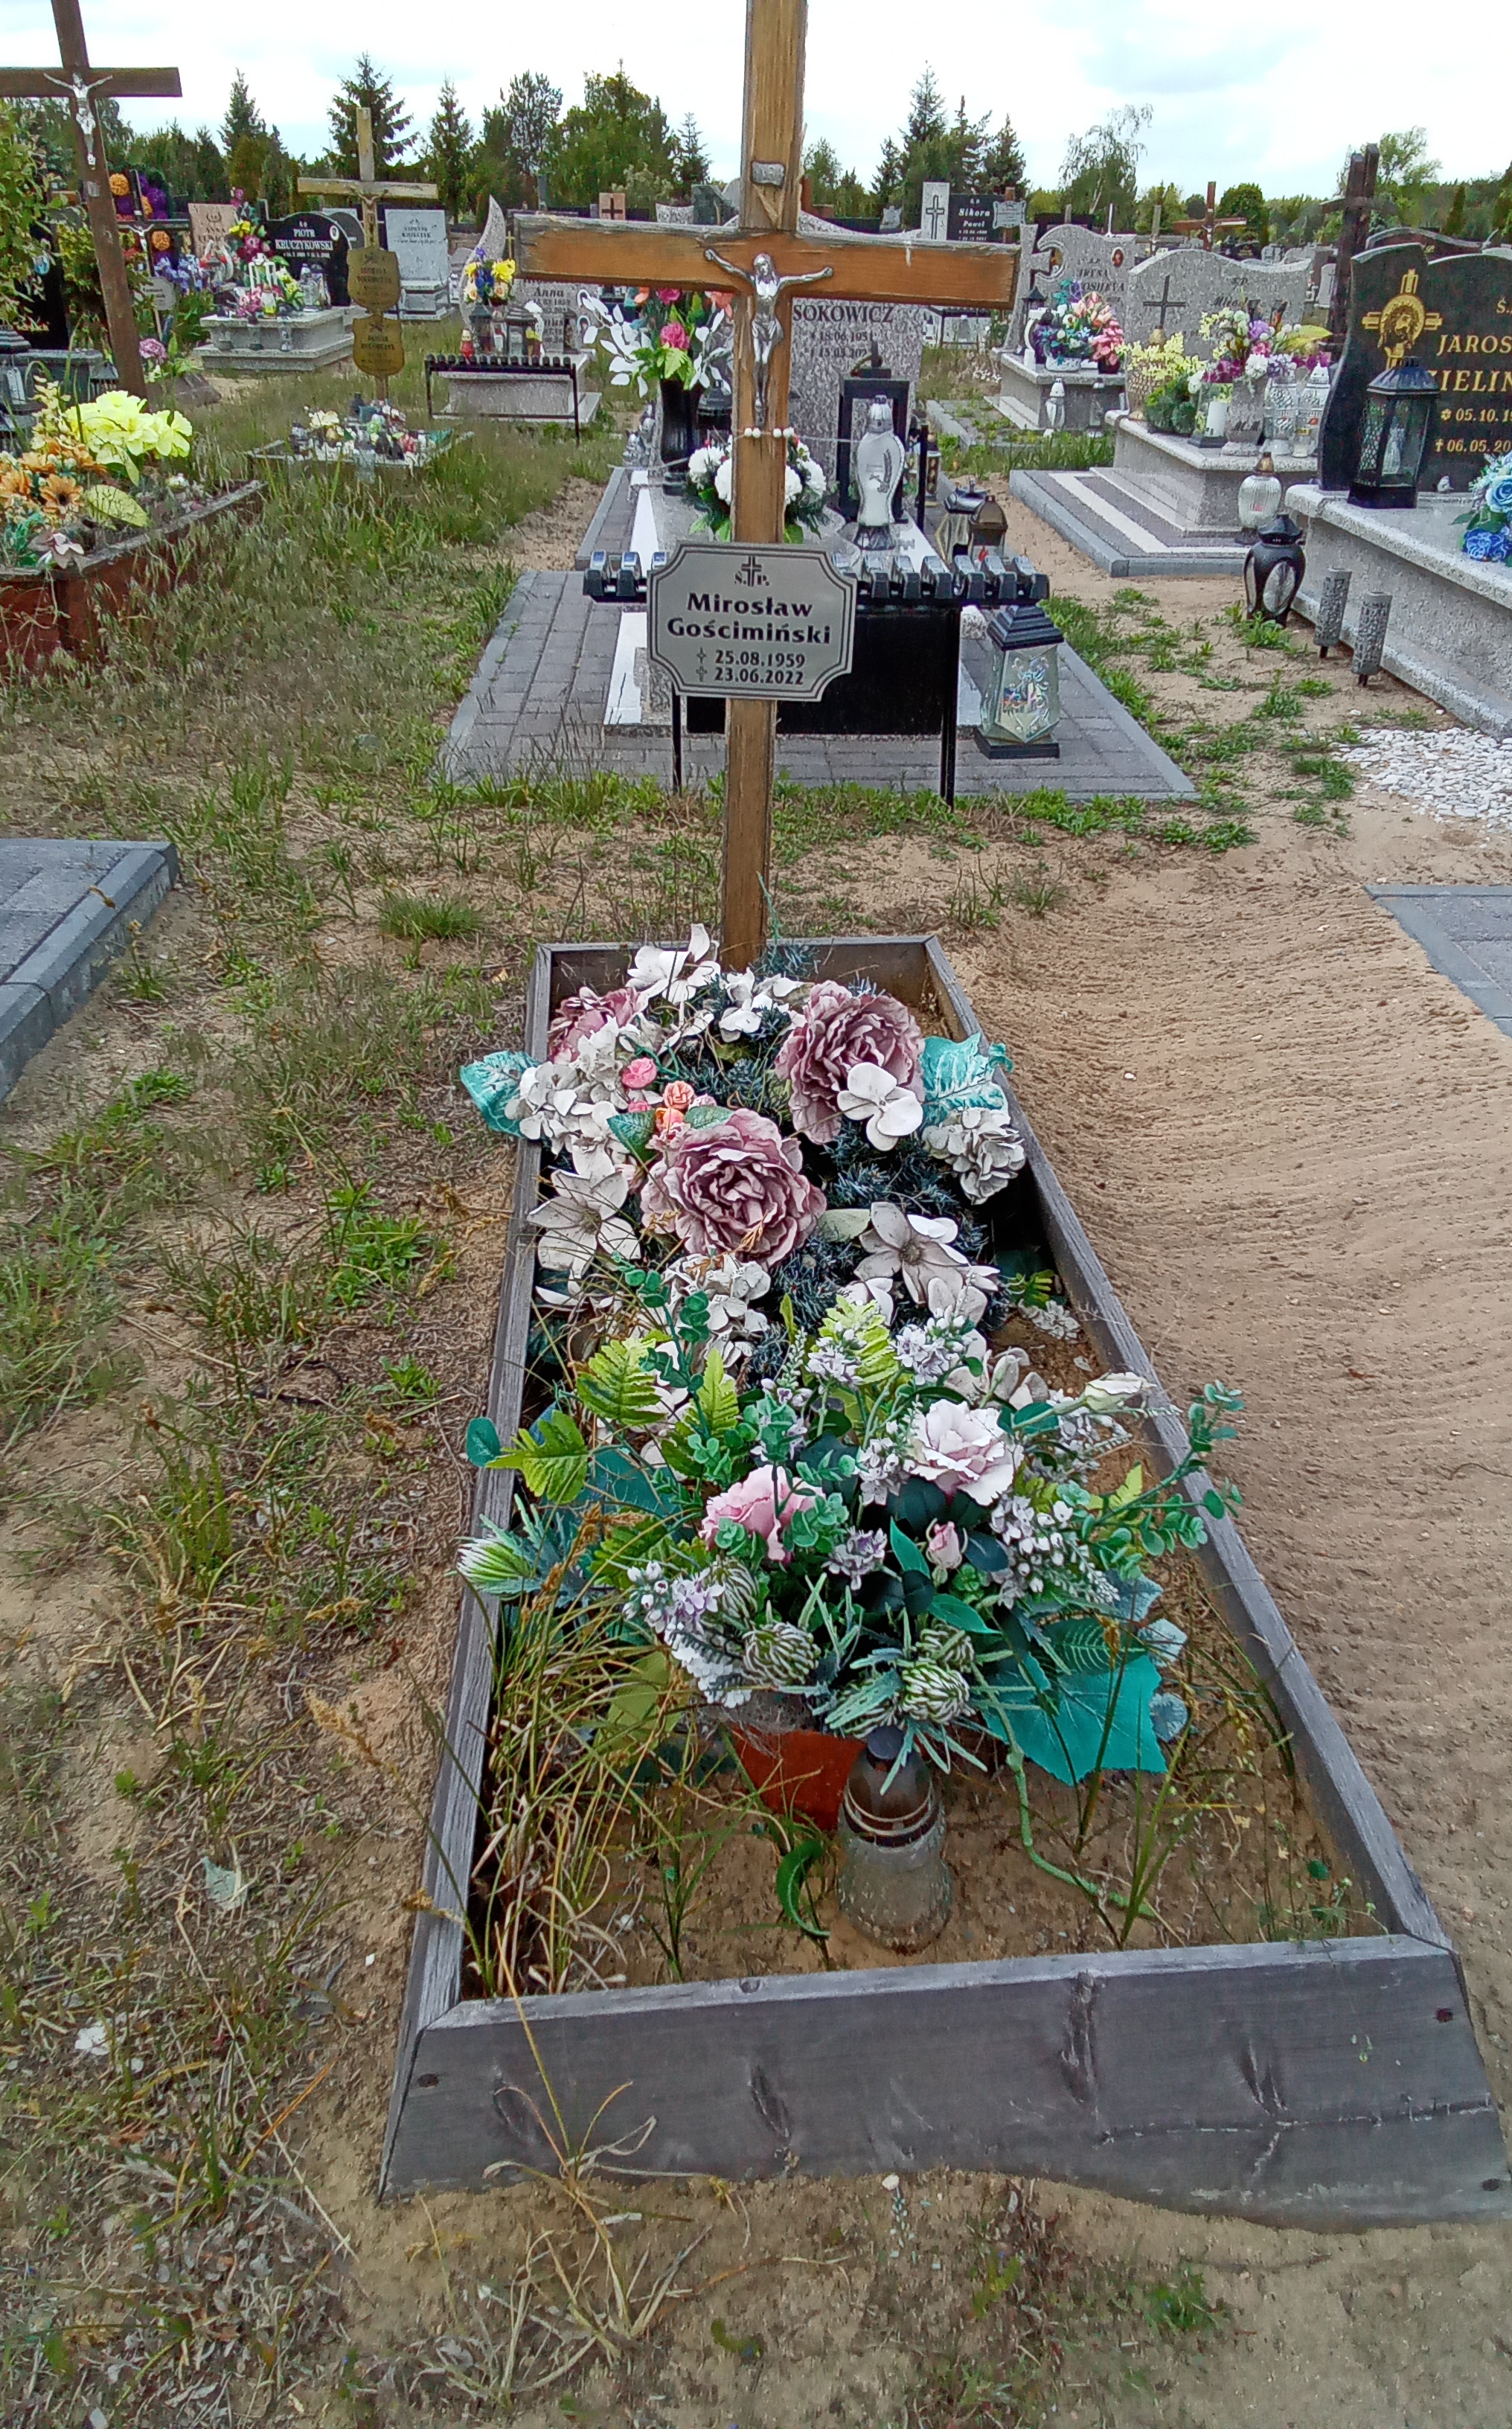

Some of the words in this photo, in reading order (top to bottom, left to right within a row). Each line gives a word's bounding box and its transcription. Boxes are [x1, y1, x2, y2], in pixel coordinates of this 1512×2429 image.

[293, 228, 315, 237] PIOTR
[275, 239, 334, 251] KRUCZYKOWSKI
[792, 304, 894, 323] SOKOWICZ
[686, 592, 813, 618] Mirosław
[667, 617, 831, 644] Gościmiński
[714, 649, 806, 668] 25.08.1959
[714, 667, 804, 685] 23.06.2022
